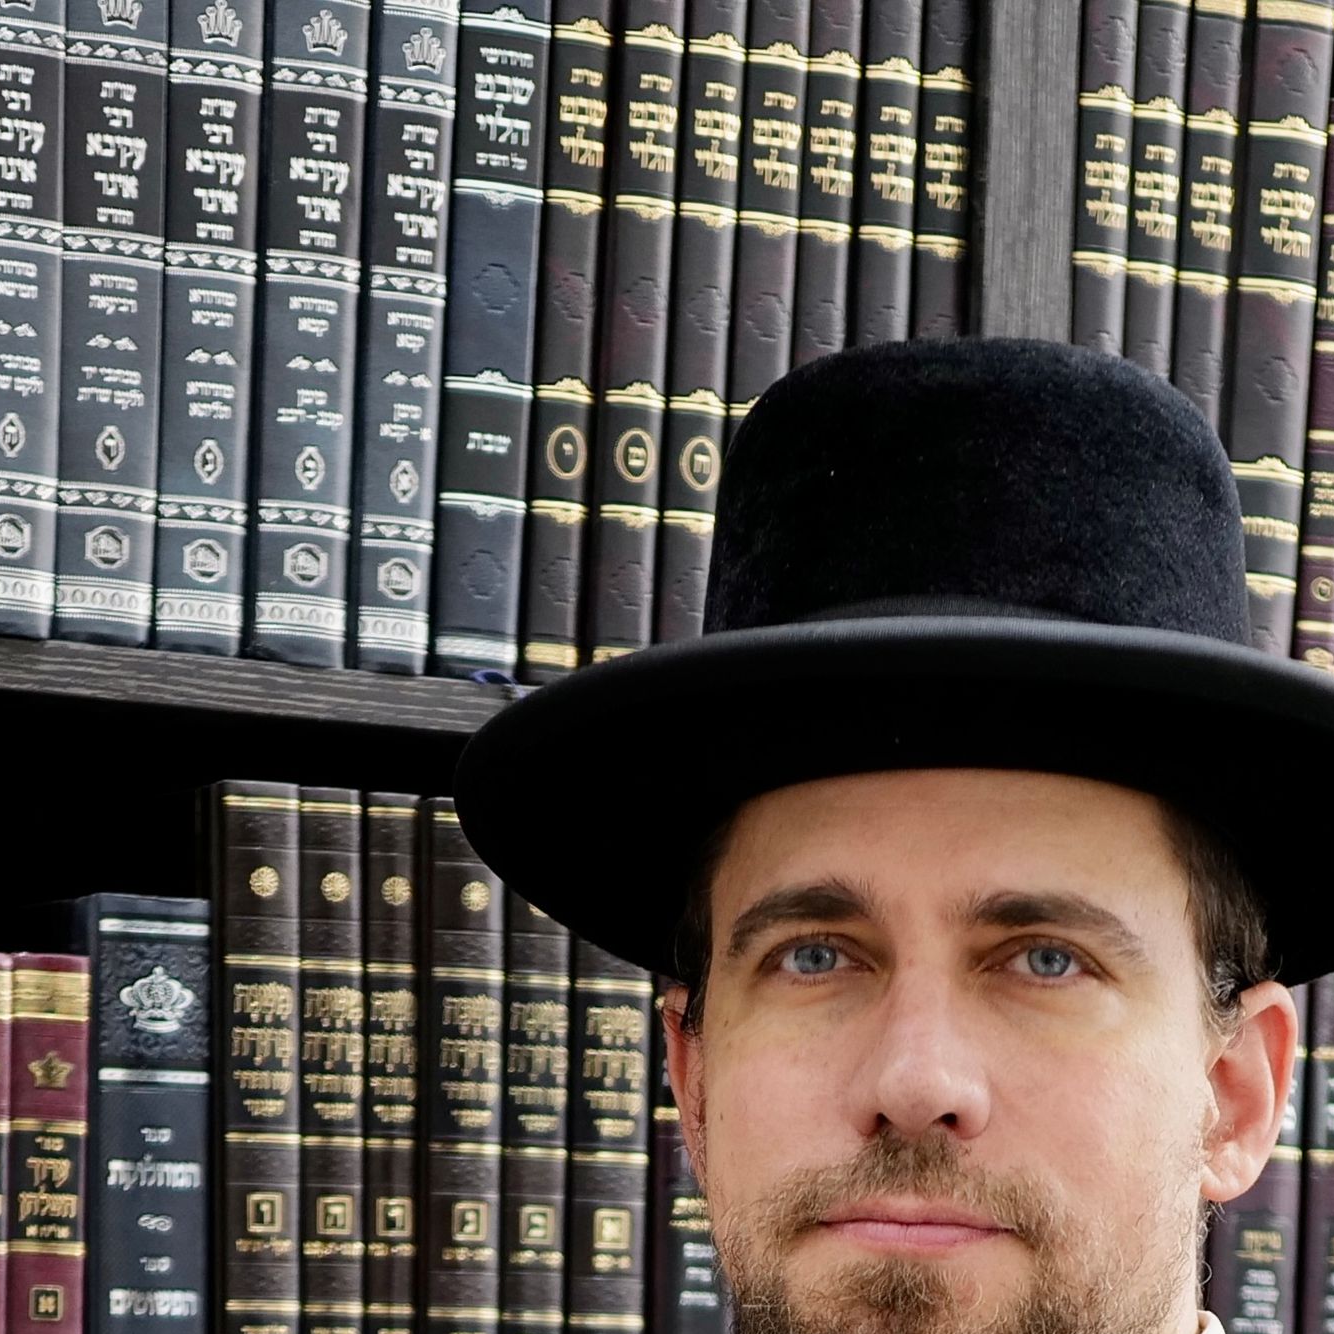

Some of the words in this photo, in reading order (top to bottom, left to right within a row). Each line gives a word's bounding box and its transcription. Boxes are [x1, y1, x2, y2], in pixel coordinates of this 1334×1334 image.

[2, 90, 31, 111] רבי
[475, 74, 535, 105] שבט
[103, 107, 133, 128] רבי
[476, 104, 531, 146] הלוי
[87, 133, 147, 170] עקיבא
[1261, 215, 1314, 262] הלוי
